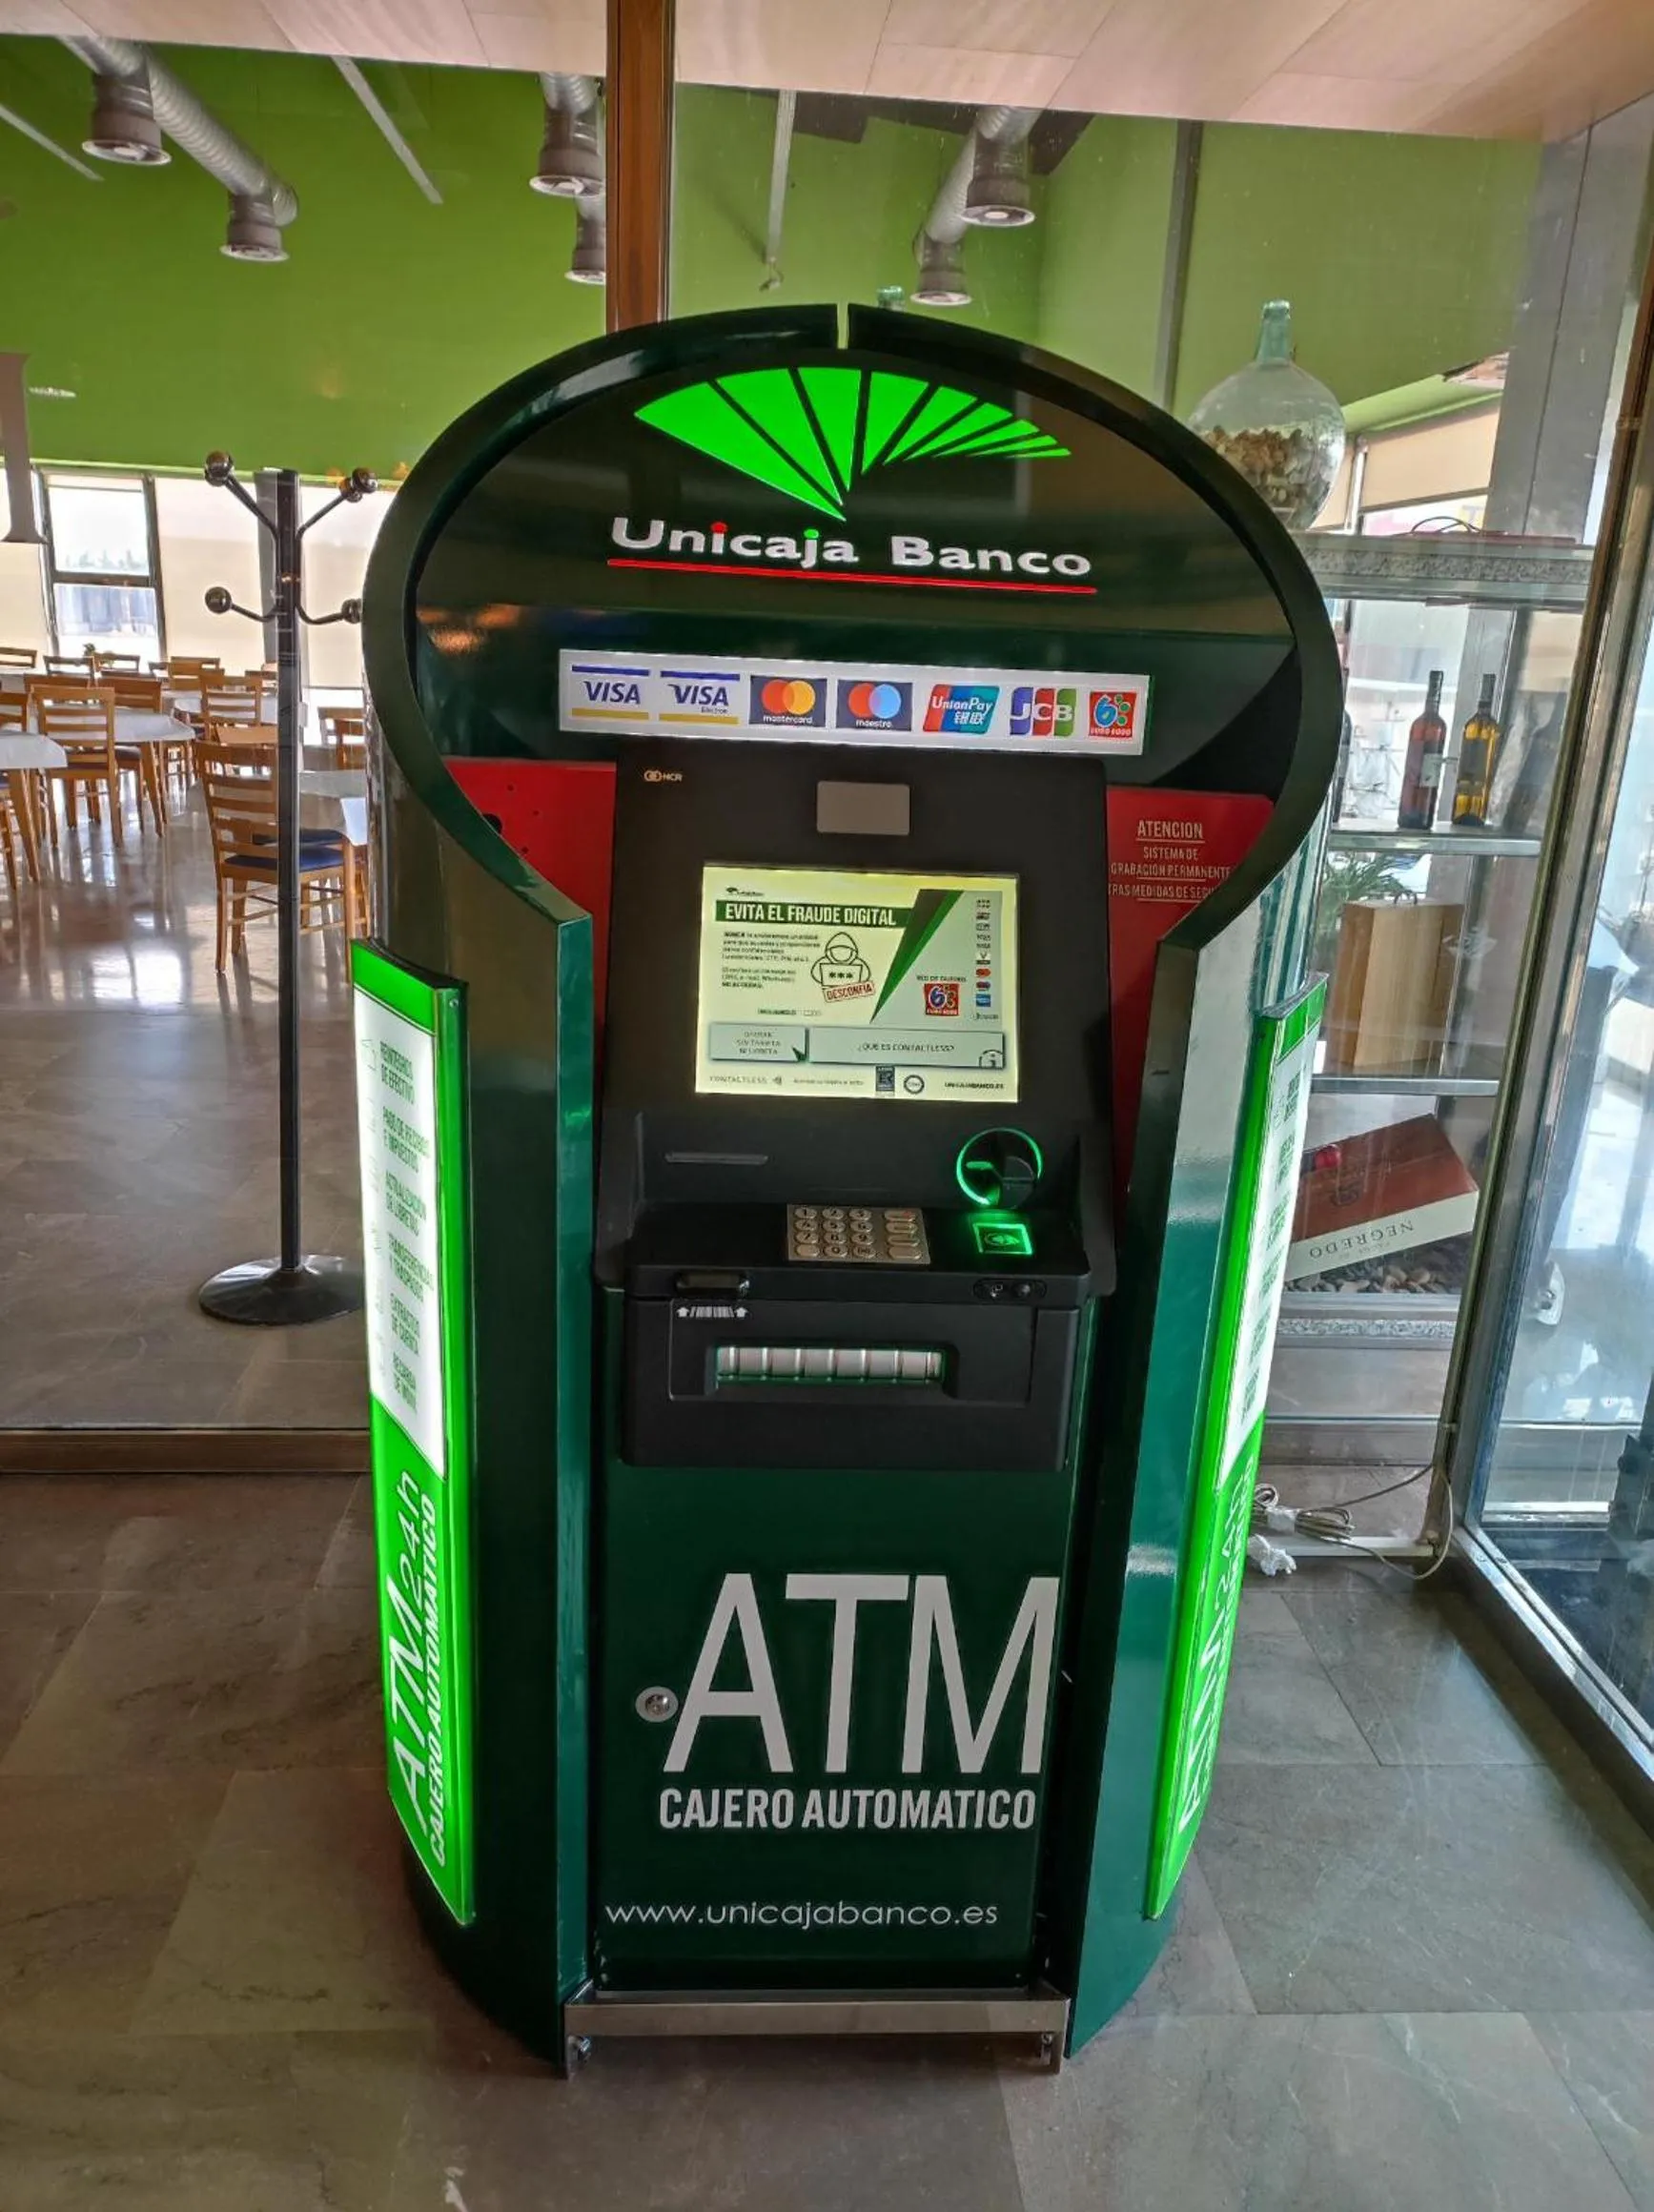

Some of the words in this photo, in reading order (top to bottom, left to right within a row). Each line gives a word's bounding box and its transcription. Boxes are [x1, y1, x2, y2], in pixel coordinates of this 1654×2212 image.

[612, 517, 859, 568] Unicaja
[891, 536, 1091, 576] Banco
[583, 680, 641, 705] VISA
[668, 684, 729, 706] VISA
[931, 696, 994, 715] UnionPay
[1010, 703, 1074, 722] JCB
[763, 715, 812, 725] mastercard
[855, 720, 891, 728] maestro
[1136, 819, 1203, 839] ATENCION
[1143, 847, 1184, 860] SISTEMA
[1185, 848, 1199, 861] DE
[1111, 862, 1166, 876] GRABACION
[1177, 886, 1189, 898] DE
[725, 903, 765, 920] EVITA
[767, 905, 785, 921] EL
[787, 906, 841, 924] FRAUDE
[844, 908, 897, 926] DIGITAL
[827, 983, 872, 1000] DESCONFIA
[1309, 1219, 1415, 1260] NEGREDO
[397, 1471, 422, 1611] 24h
[421, 1493, 441, 1737] AUTOMATICO
[663, 1572, 1061, 1774] ATM
[386, 1573, 427, 1837] ATM
[429, 1731, 445, 1867] CAJERO
[660, 1788, 793, 1830] CAJERO
[801, 1789, 1036, 1830] AUTOMATICO
[605, 1900, 998, 1931] www.unicajabanco.es
